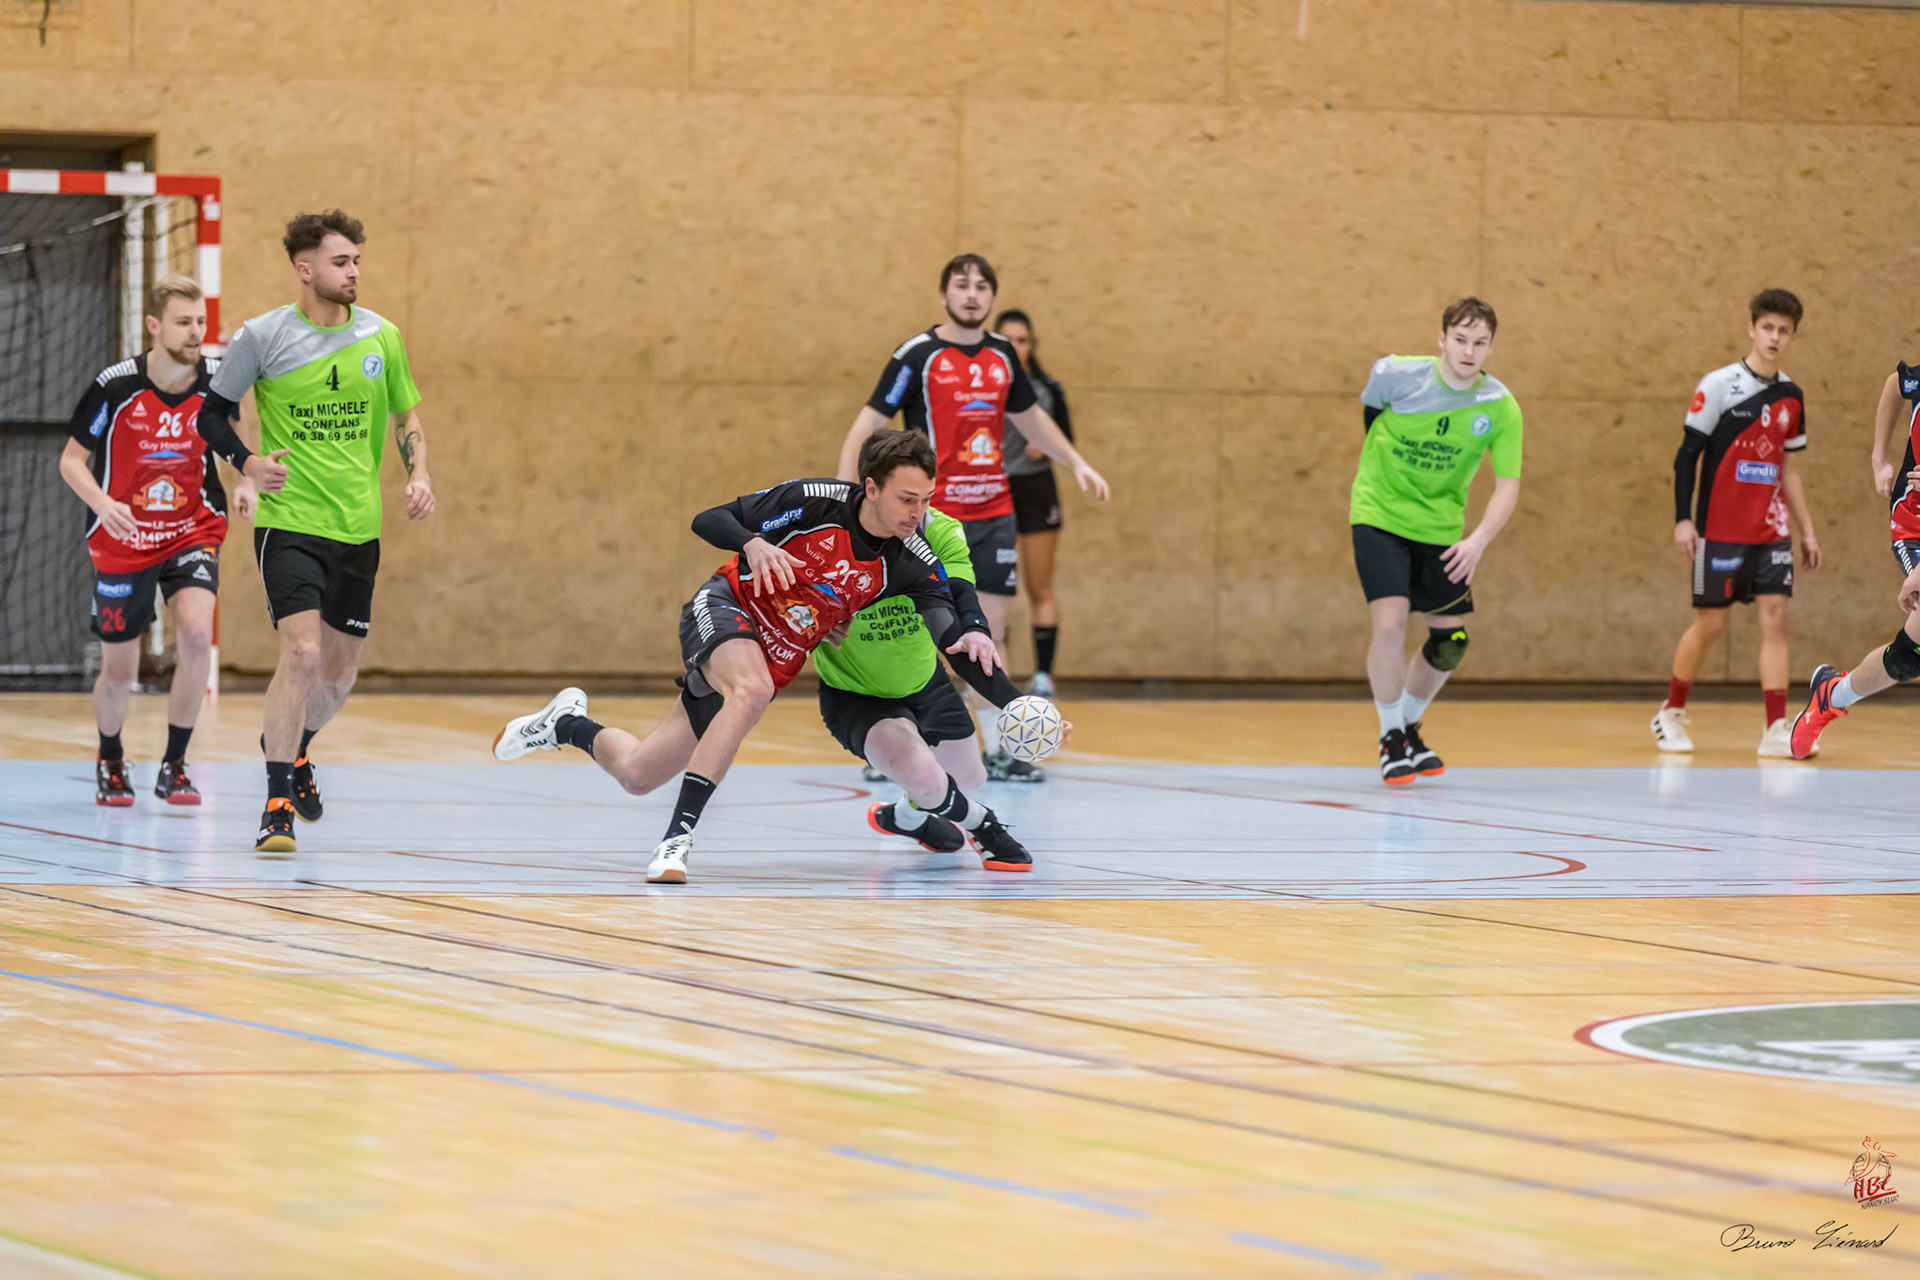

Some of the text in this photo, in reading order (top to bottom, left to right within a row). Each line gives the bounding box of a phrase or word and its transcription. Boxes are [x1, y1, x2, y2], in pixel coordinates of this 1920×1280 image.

[325, 364, 340, 391] 4
[969, 363, 983, 388] 2
[289, 405, 314, 418] Taxi
[1761, 403, 1771, 428] 6
[155, 411, 184, 438] 26
[303, 418, 360, 429] CONFLANS
[1436, 416, 1450, 437] 9
[292, 431, 306, 441] 06
[310, 431, 325, 441] 38
[328, 431, 341, 441] 69
[344, 430, 357, 441] 56
[153, 521, 164, 530] LE
[762, 511, 789, 530] Grand
[102, 606, 125, 631] 26
[860, 632, 874, 641] 06
[892, 627, 905, 639] 69
